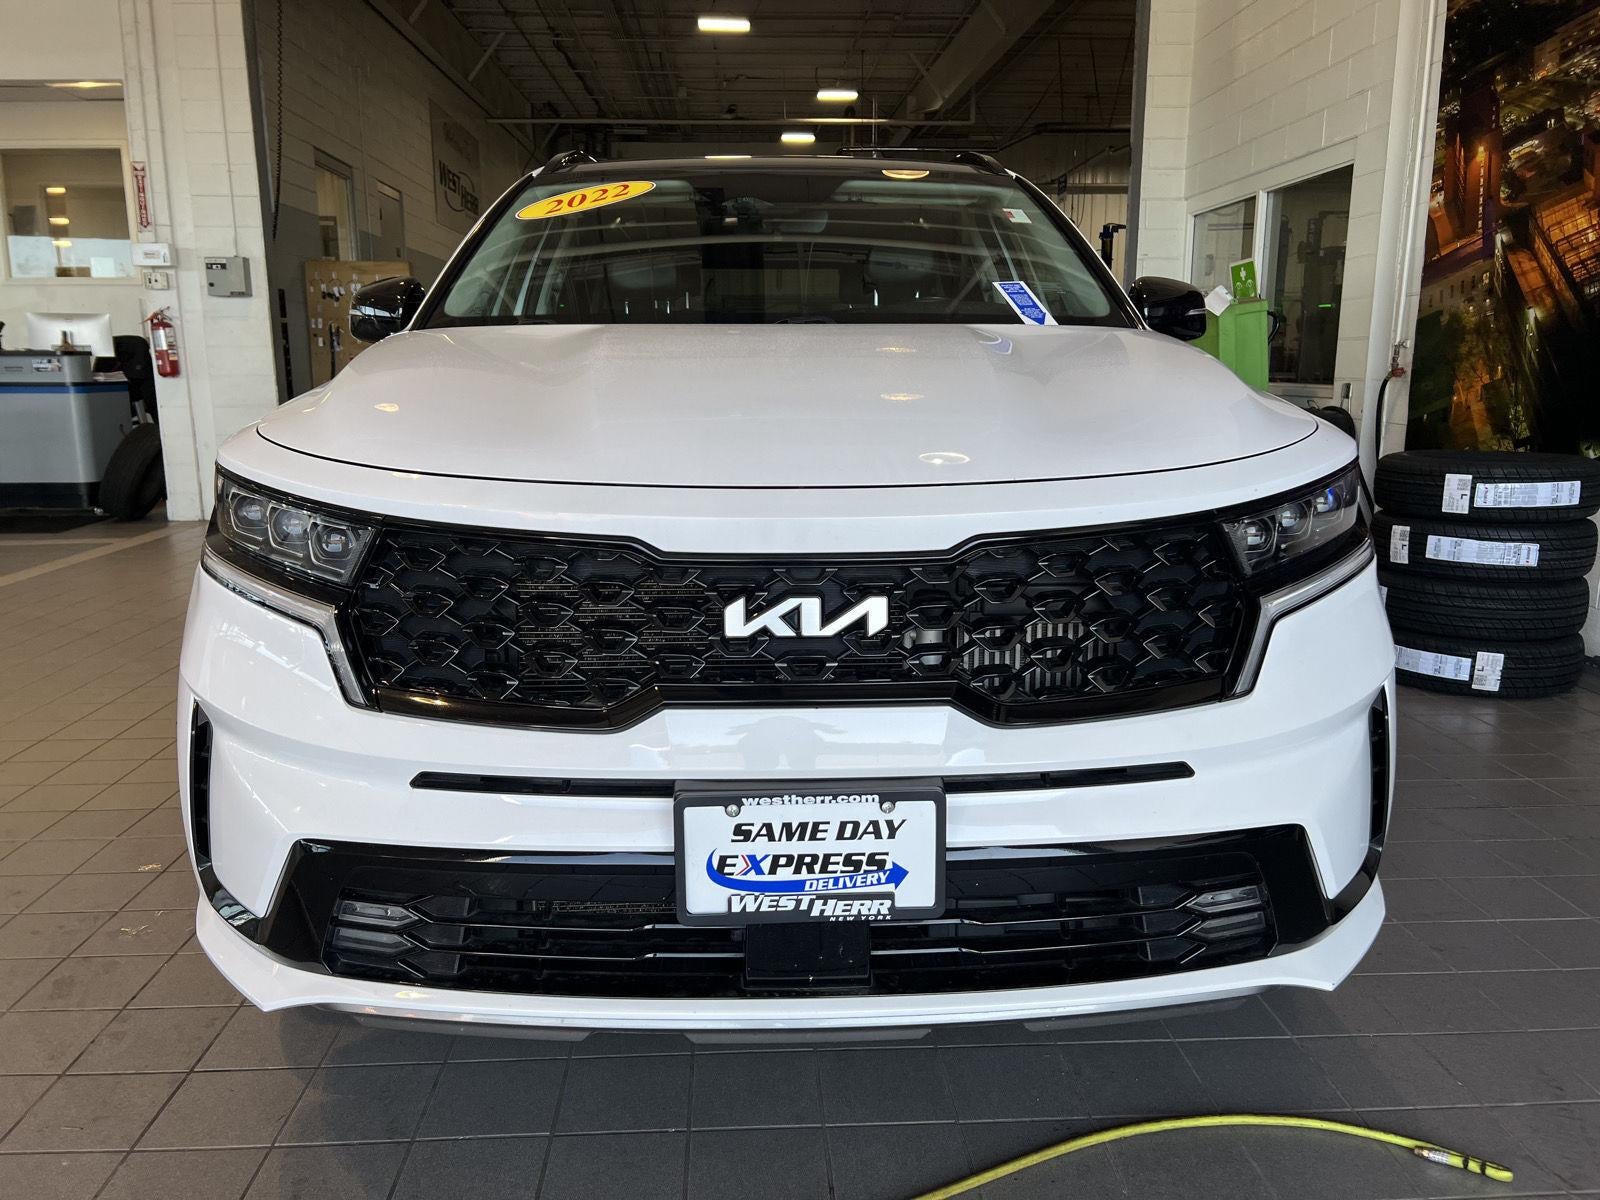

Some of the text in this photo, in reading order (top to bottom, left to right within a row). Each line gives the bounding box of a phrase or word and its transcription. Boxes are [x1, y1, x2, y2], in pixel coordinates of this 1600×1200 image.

[439, 160, 460, 196] WEST
[545, 184, 630, 215] 2022
[723, 595, 889, 638] KIA
[741, 794, 880, 807] westherr.com
[731, 819, 907, 842] SAME DAY
[716, 852, 889, 876] EXPRESS
[804, 871, 890, 892] DELIVERY
[730, 894, 893, 917] WEST HERR
